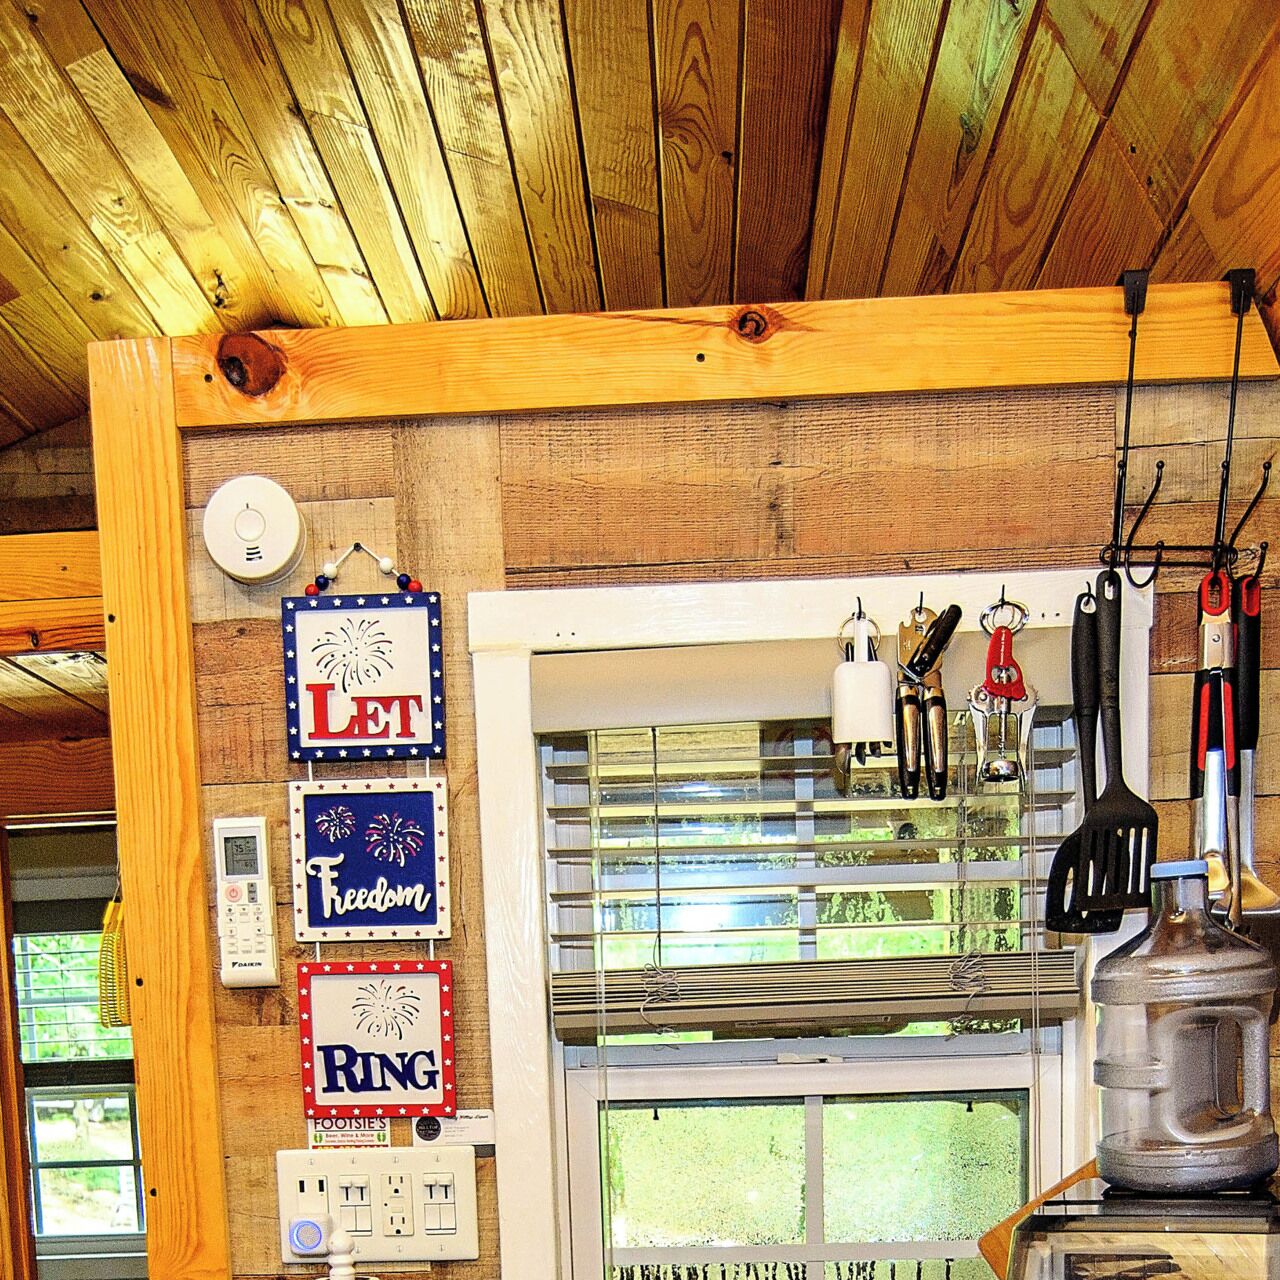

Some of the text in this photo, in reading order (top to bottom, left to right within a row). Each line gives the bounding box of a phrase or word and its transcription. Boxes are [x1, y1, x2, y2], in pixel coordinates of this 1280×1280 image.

[305, 682, 423, 740] LET
[305, 852, 431, 919] Freedom
[316, 1043, 440, 1094] RING
[314, 1118, 386, 1130] FOOTSIE'S
